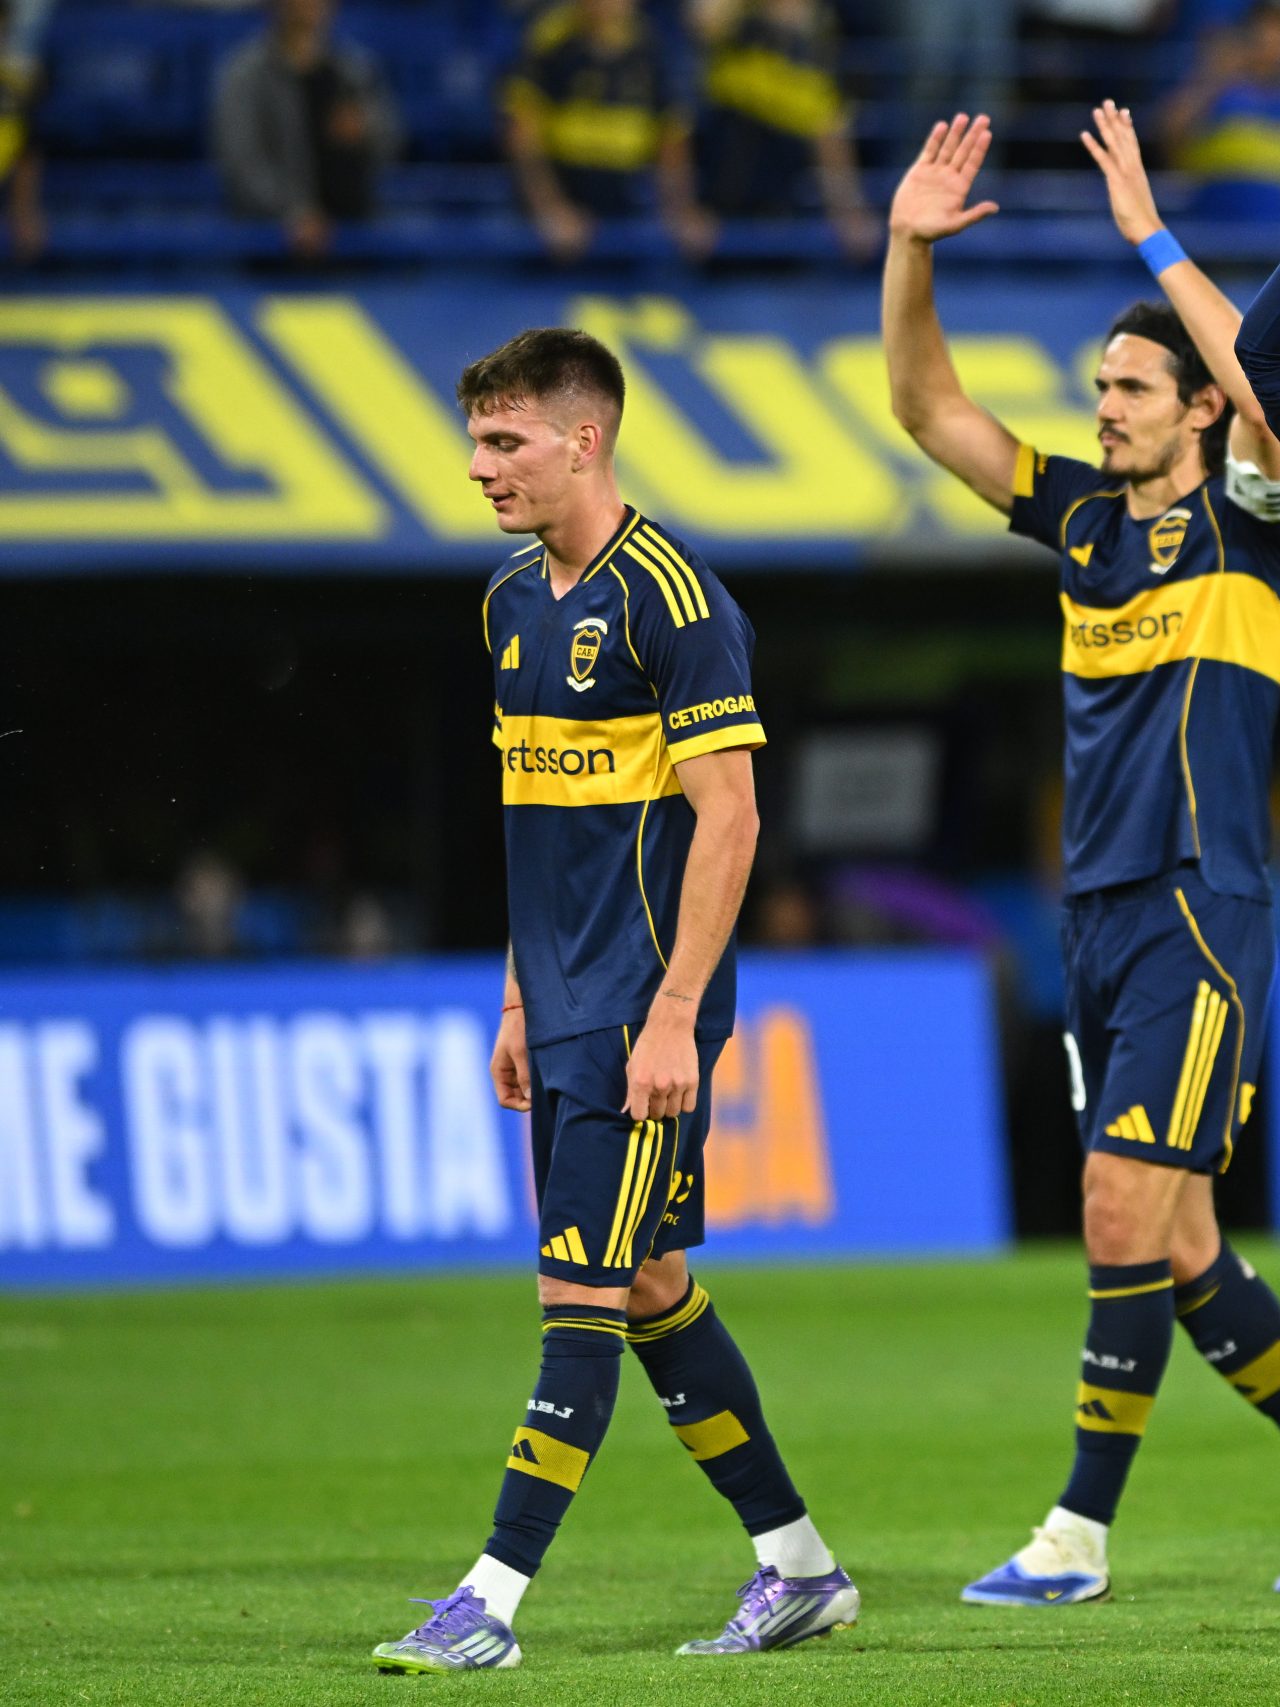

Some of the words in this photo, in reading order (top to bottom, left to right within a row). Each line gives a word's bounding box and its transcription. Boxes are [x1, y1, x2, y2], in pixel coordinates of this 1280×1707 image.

[576, 647, 596, 657] CABJ
[669, 695, 756, 729] CETROGAR
[503, 738, 616, 775] etsson
[122, 1008, 512, 1248] GUSTA
